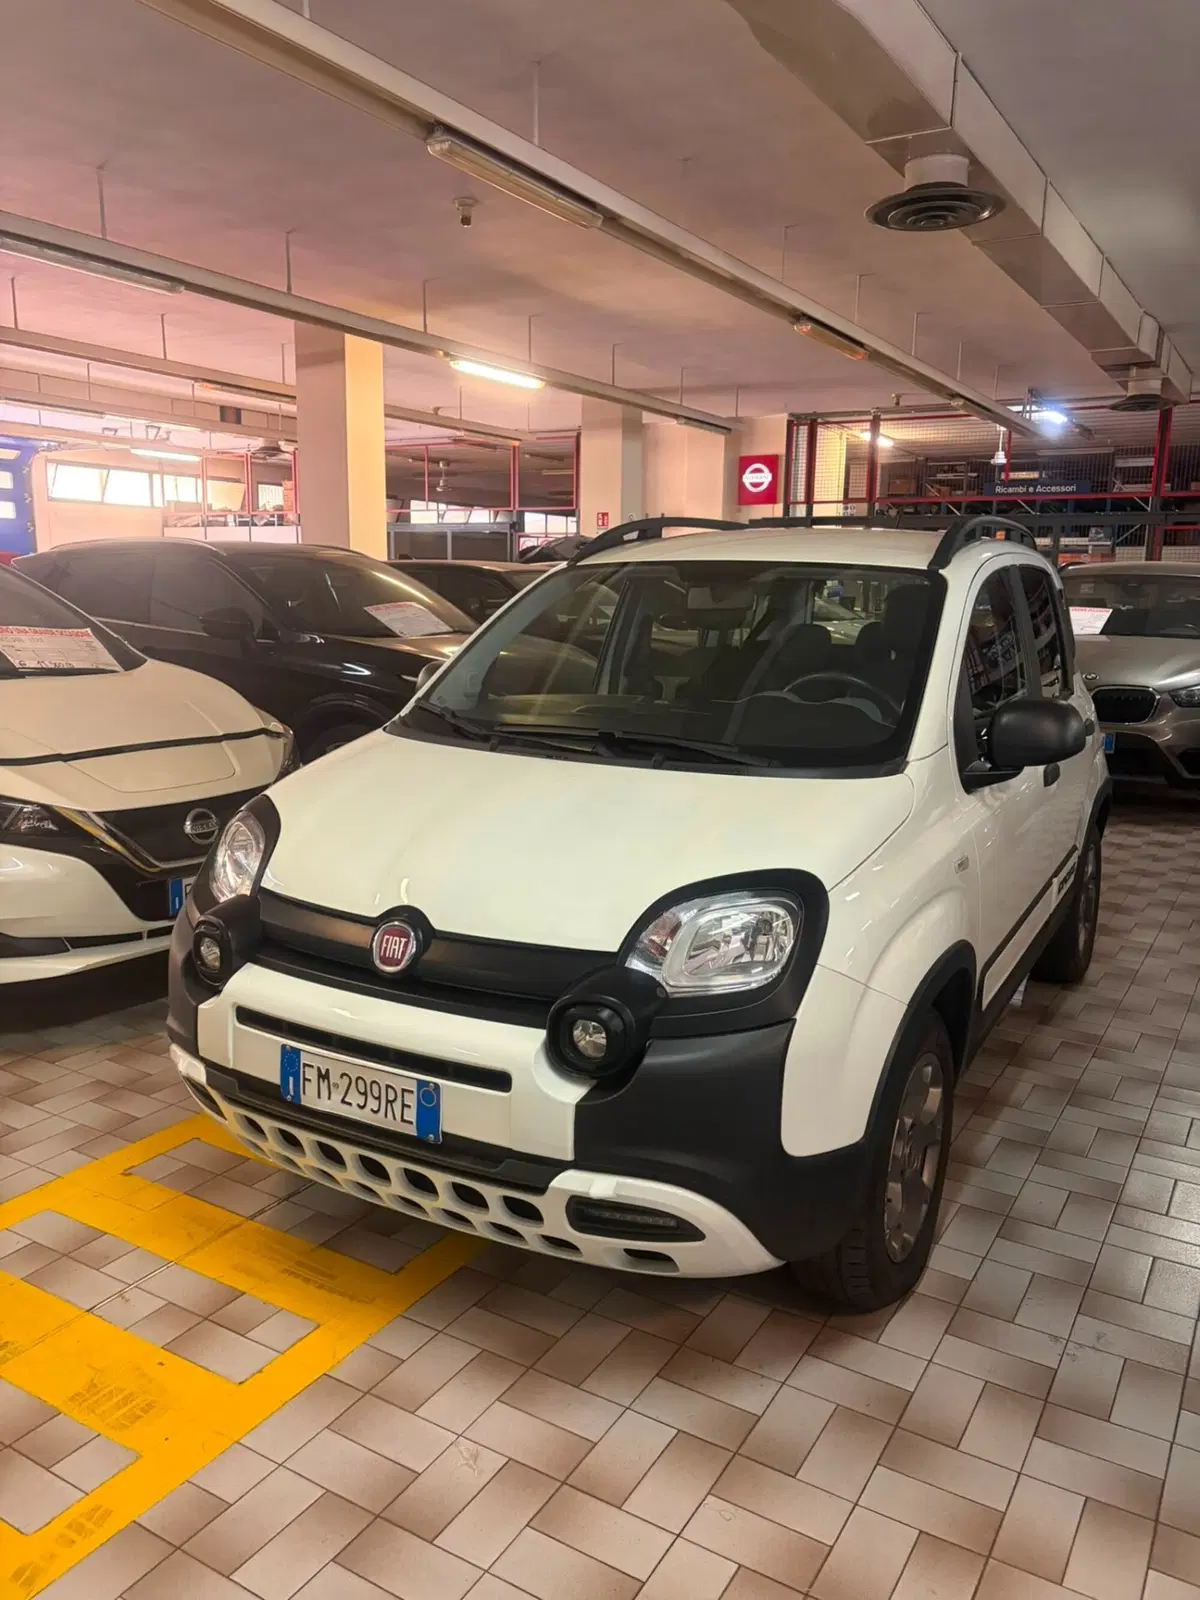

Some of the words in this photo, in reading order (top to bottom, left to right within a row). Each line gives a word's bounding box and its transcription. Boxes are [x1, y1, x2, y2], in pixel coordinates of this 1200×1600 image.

[995, 484, 1027, 494] Ricambi
[1036, 483, 1077, 493] Accessori
[380, 935, 408, 959] FIAT
